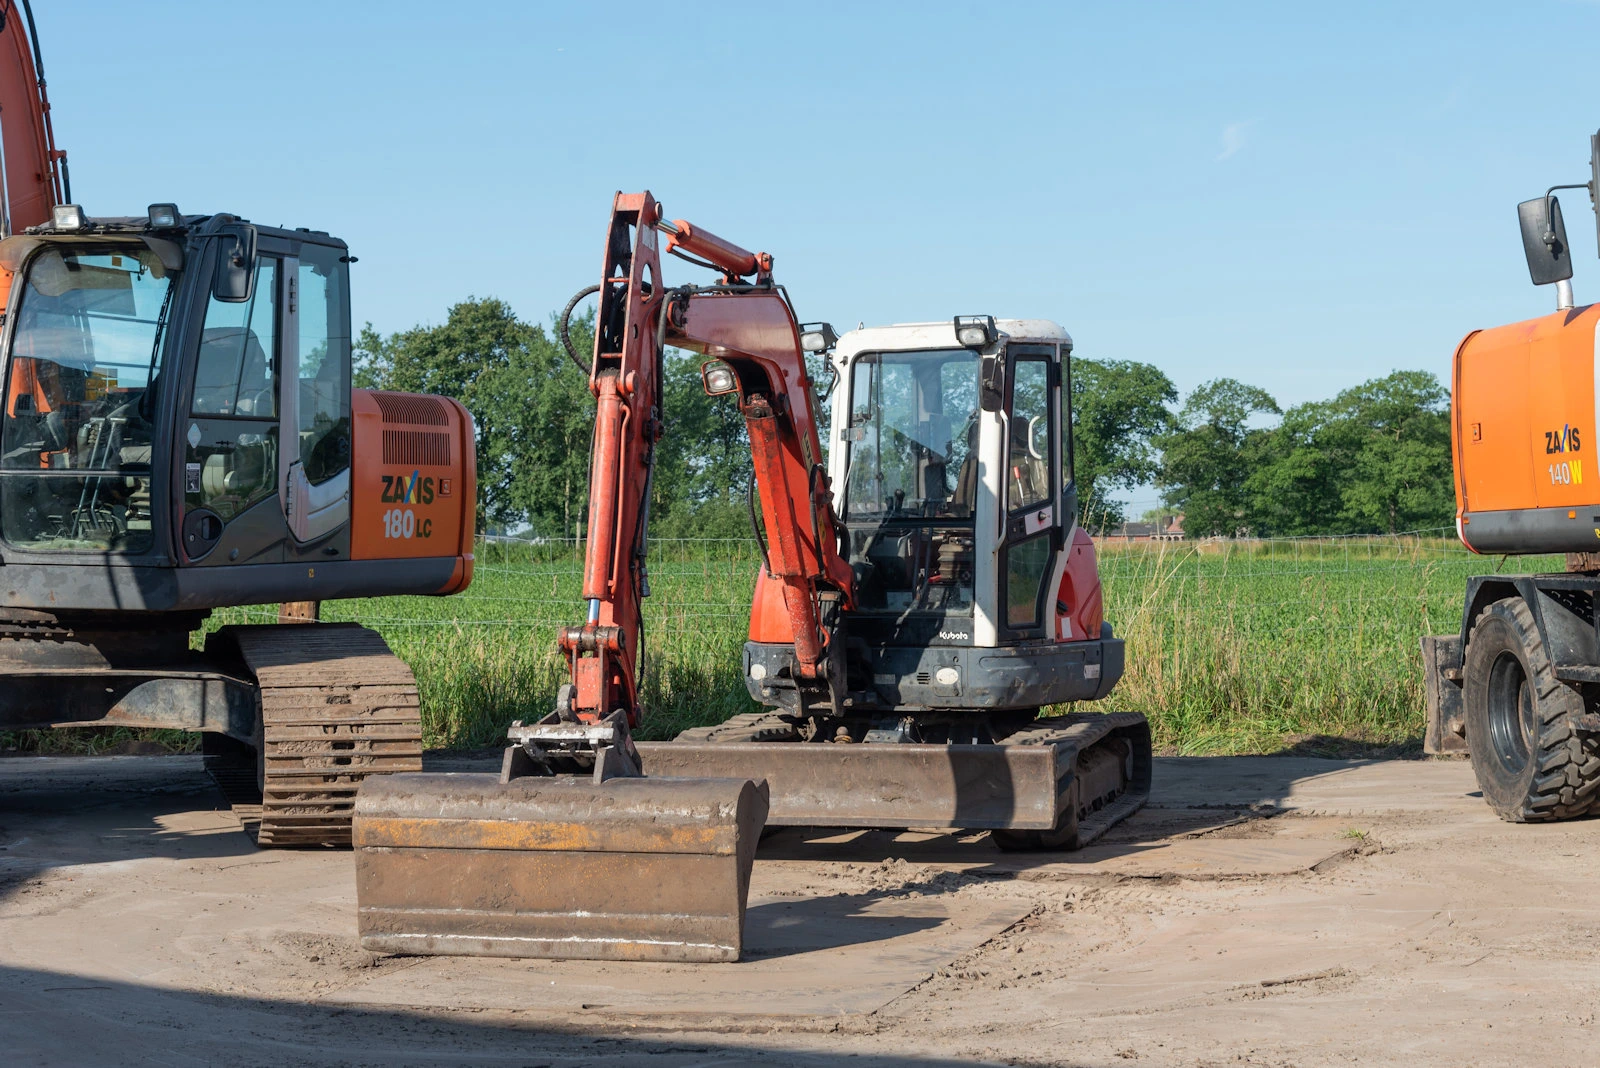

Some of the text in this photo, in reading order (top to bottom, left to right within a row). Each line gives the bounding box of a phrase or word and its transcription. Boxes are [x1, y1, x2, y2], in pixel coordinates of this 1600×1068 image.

[1545, 424, 1581, 454] ZAXIS
[381, 469, 434, 504] ZAXIS
[382, 508, 432, 539] 180 LC
[939, 631, 968, 640] Kubota
